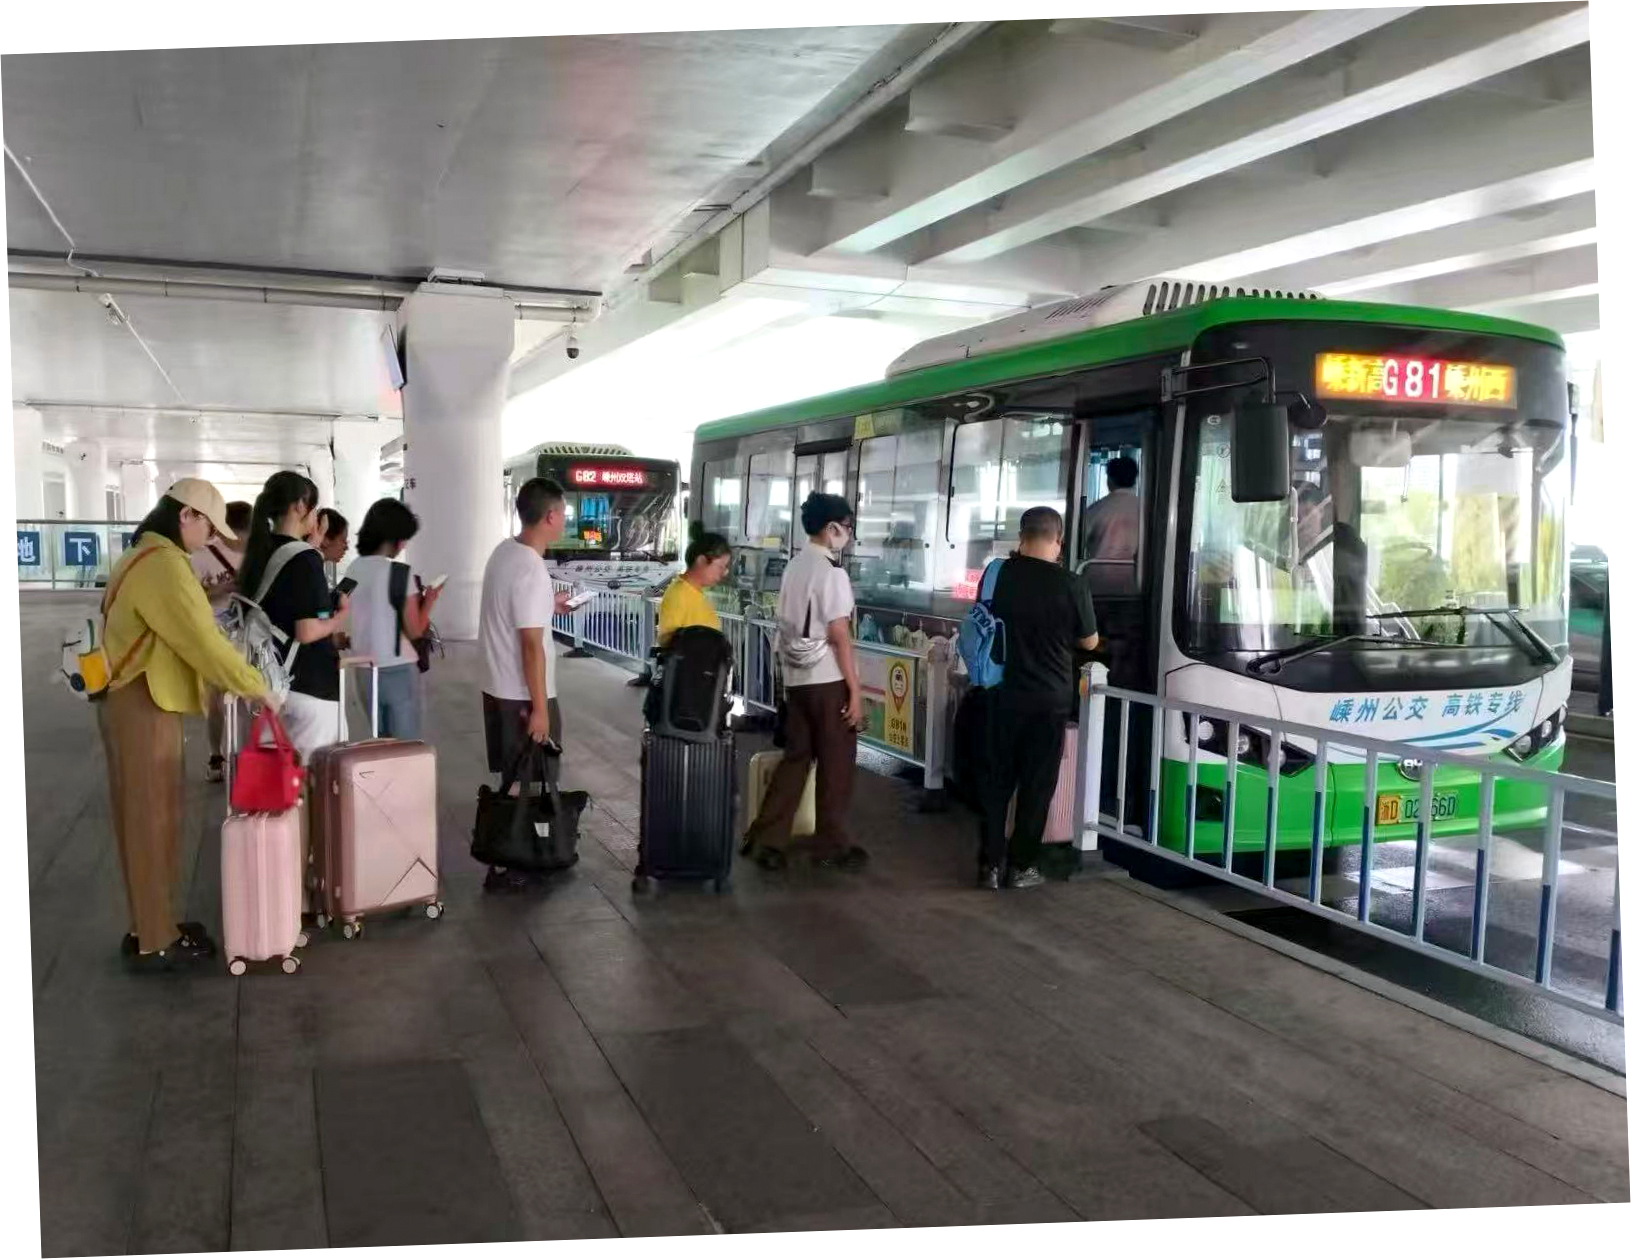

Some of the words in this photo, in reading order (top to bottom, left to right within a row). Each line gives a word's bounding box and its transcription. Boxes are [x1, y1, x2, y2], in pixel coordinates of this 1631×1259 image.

[1382, 359, 1440, 399] G81
[575, 470, 596, 483] G82
[69, 537, 92, 562] 下
[1329, 695, 1429, 723] 嵊州公交
[1442, 690, 1526, 718] 高铁专线
[1404, 796, 1456, 819] 0266D
